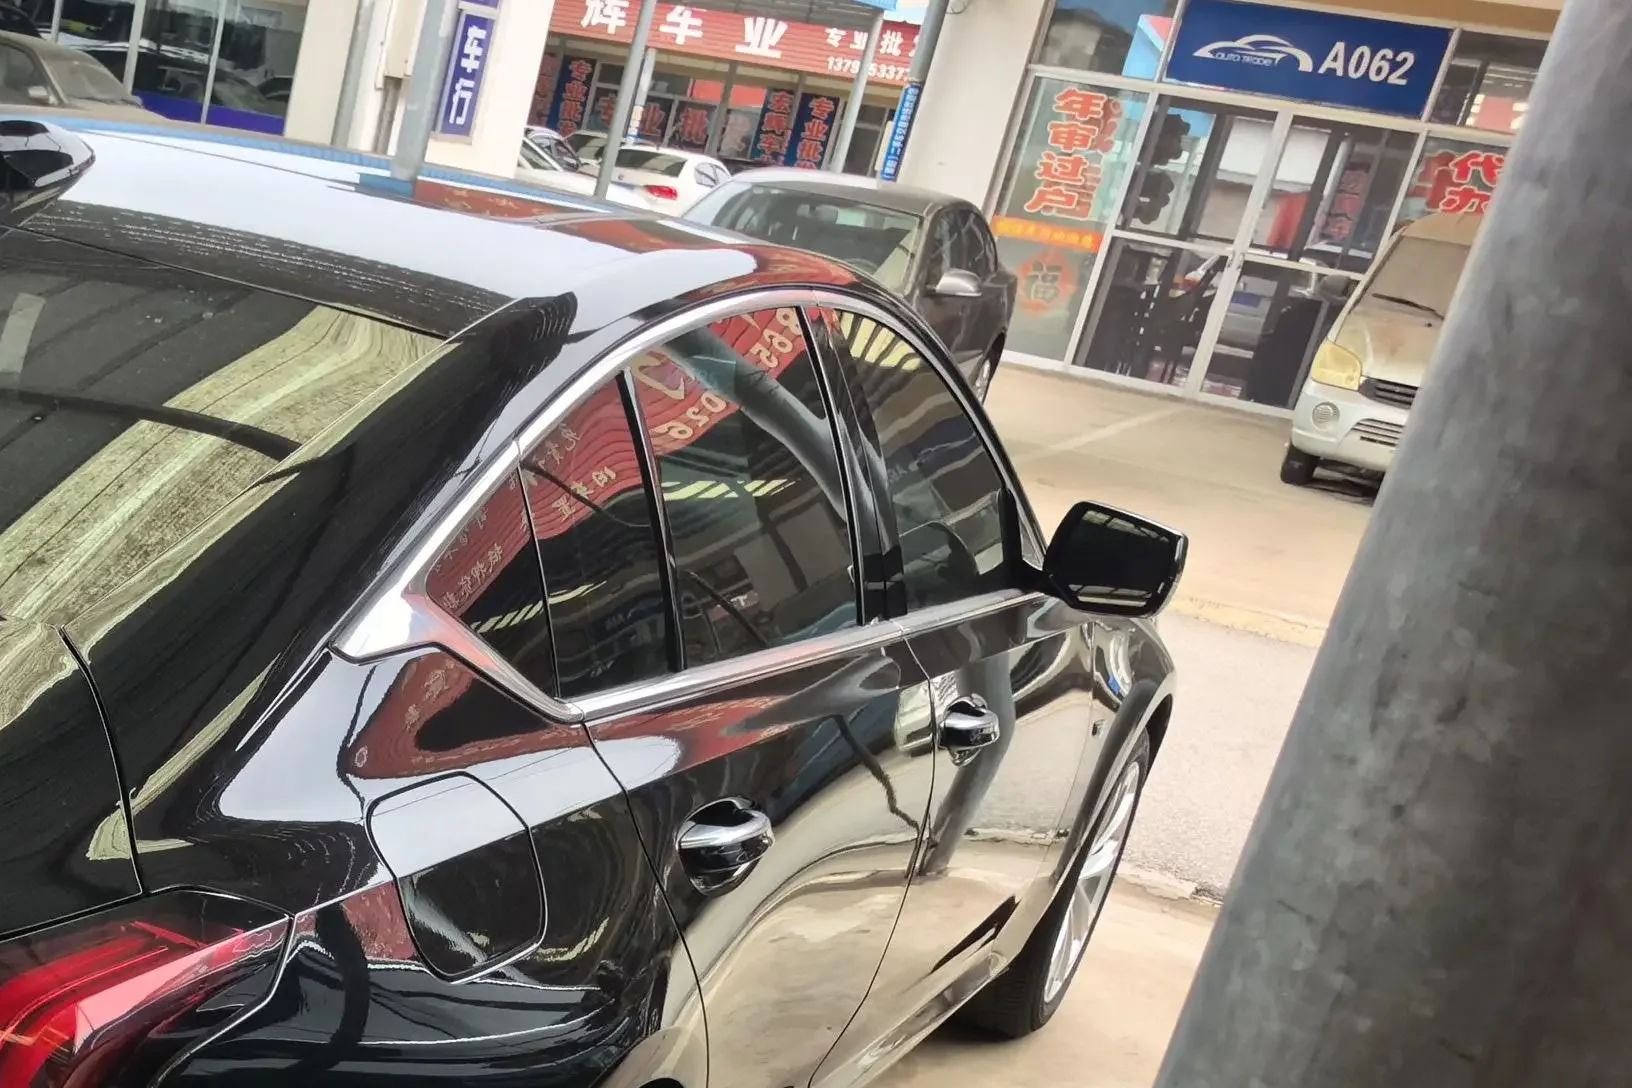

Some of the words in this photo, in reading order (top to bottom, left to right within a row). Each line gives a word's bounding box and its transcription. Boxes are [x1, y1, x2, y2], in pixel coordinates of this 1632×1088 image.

[825, 28, 920, 57] 专业批
[1318, 41, 1416, 86] A062
[1023, 87, 1108, 213] 年审过户
